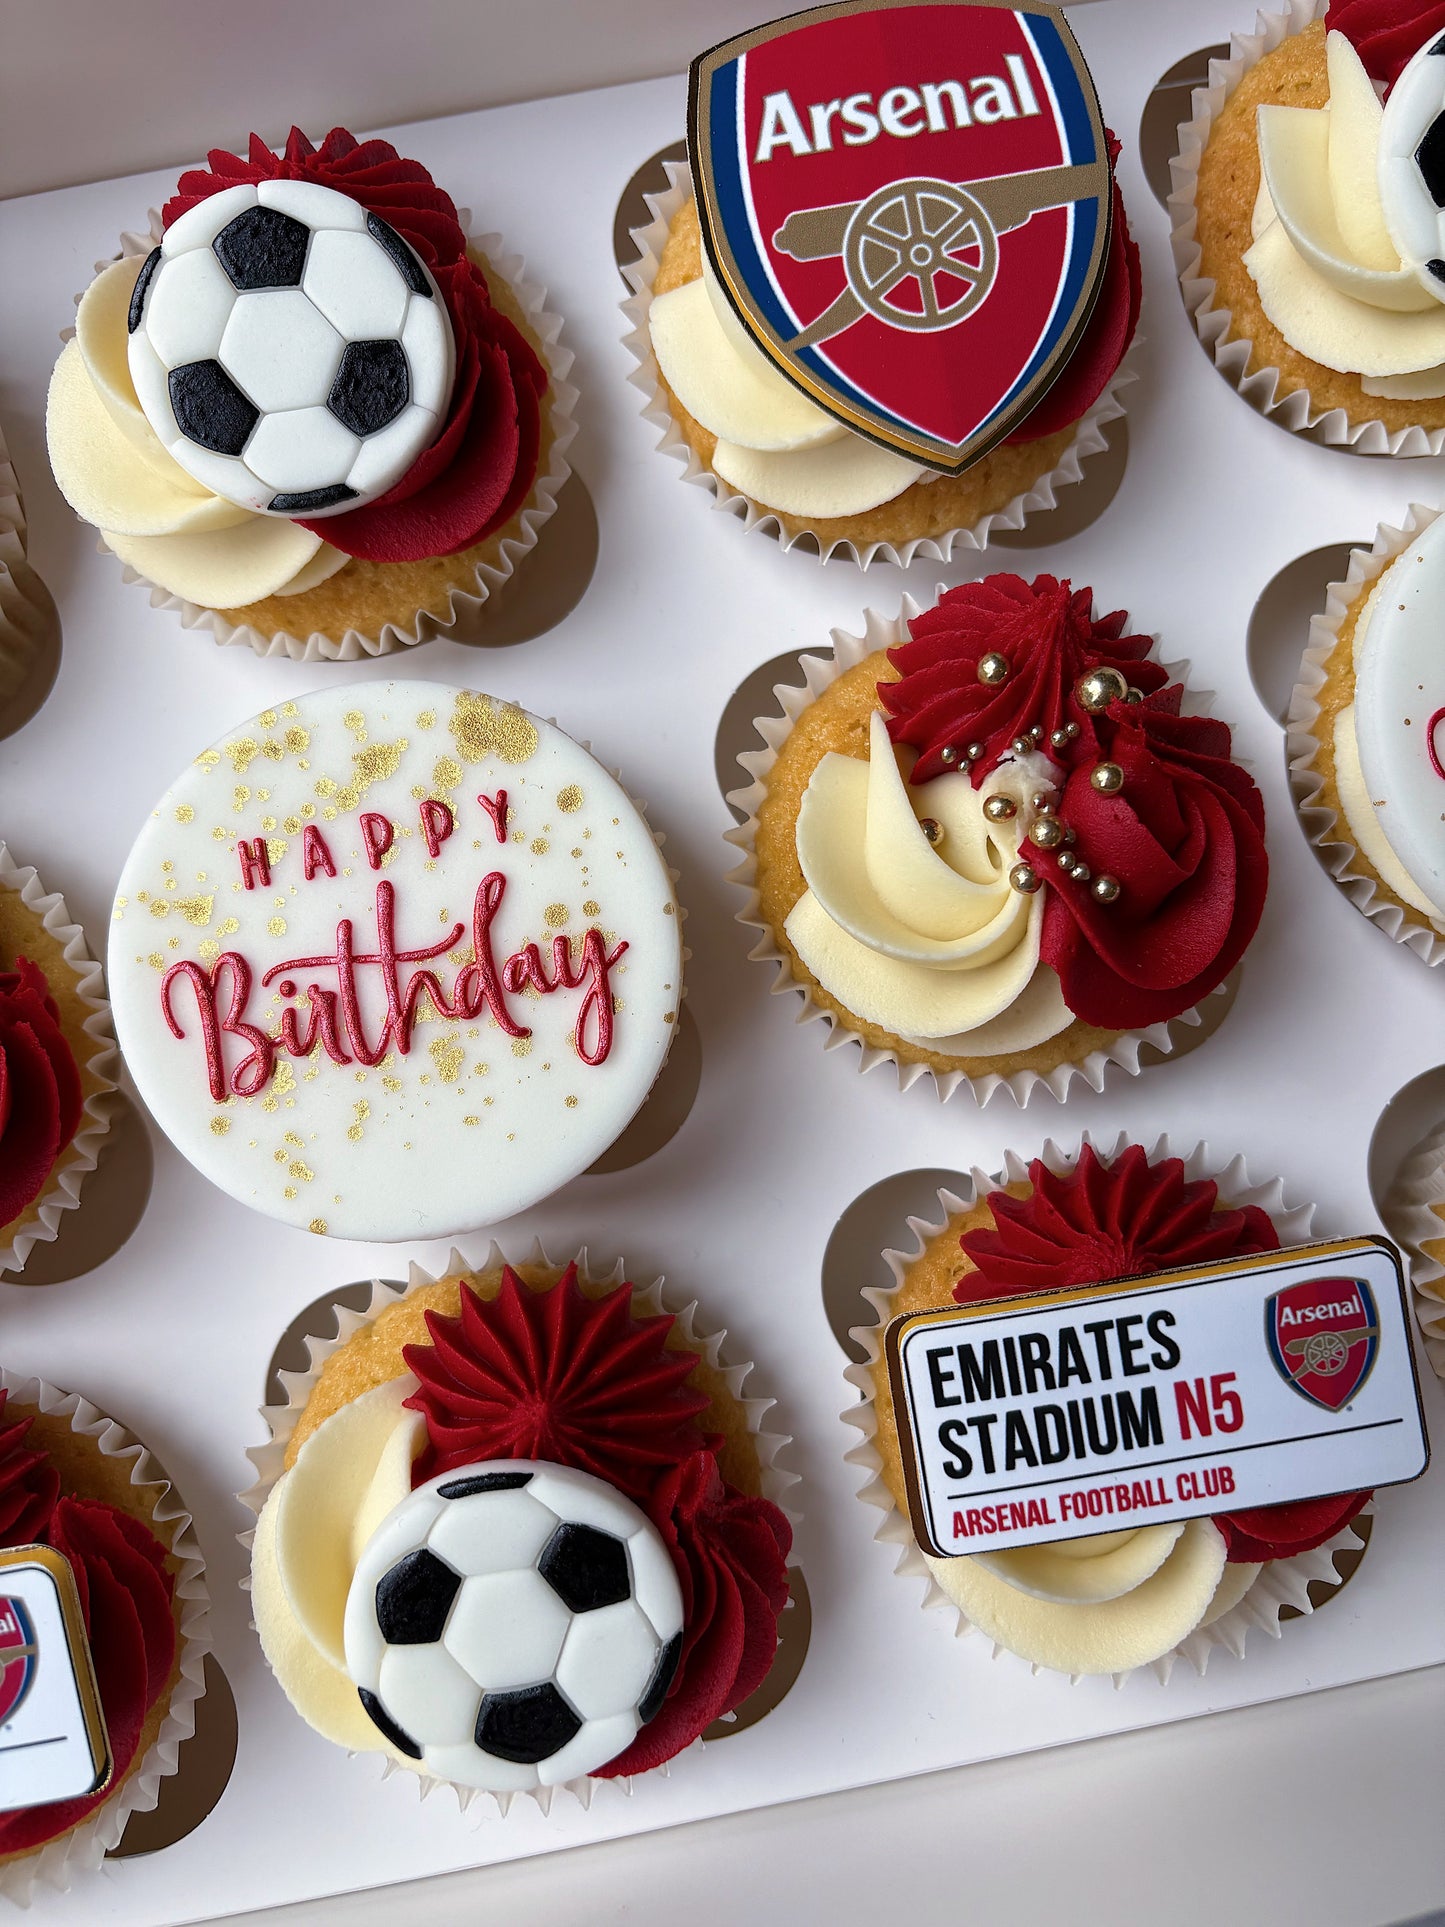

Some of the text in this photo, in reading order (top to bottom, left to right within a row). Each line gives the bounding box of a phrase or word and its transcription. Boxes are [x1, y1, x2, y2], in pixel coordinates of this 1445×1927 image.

[755, 54, 1040, 163] Arsenal
[238, 790, 507, 890] HAPPY
[161, 871, 629, 1101] Birthday
[927, 1310, 1181, 1408] EMIRATES
[1280, 1294, 1361, 1328] Arsenal
[938, 1372, 1244, 1479] STADIUM N5
[952, 1466, 1236, 1539] ARSENAL FOOTBALL CLUB
